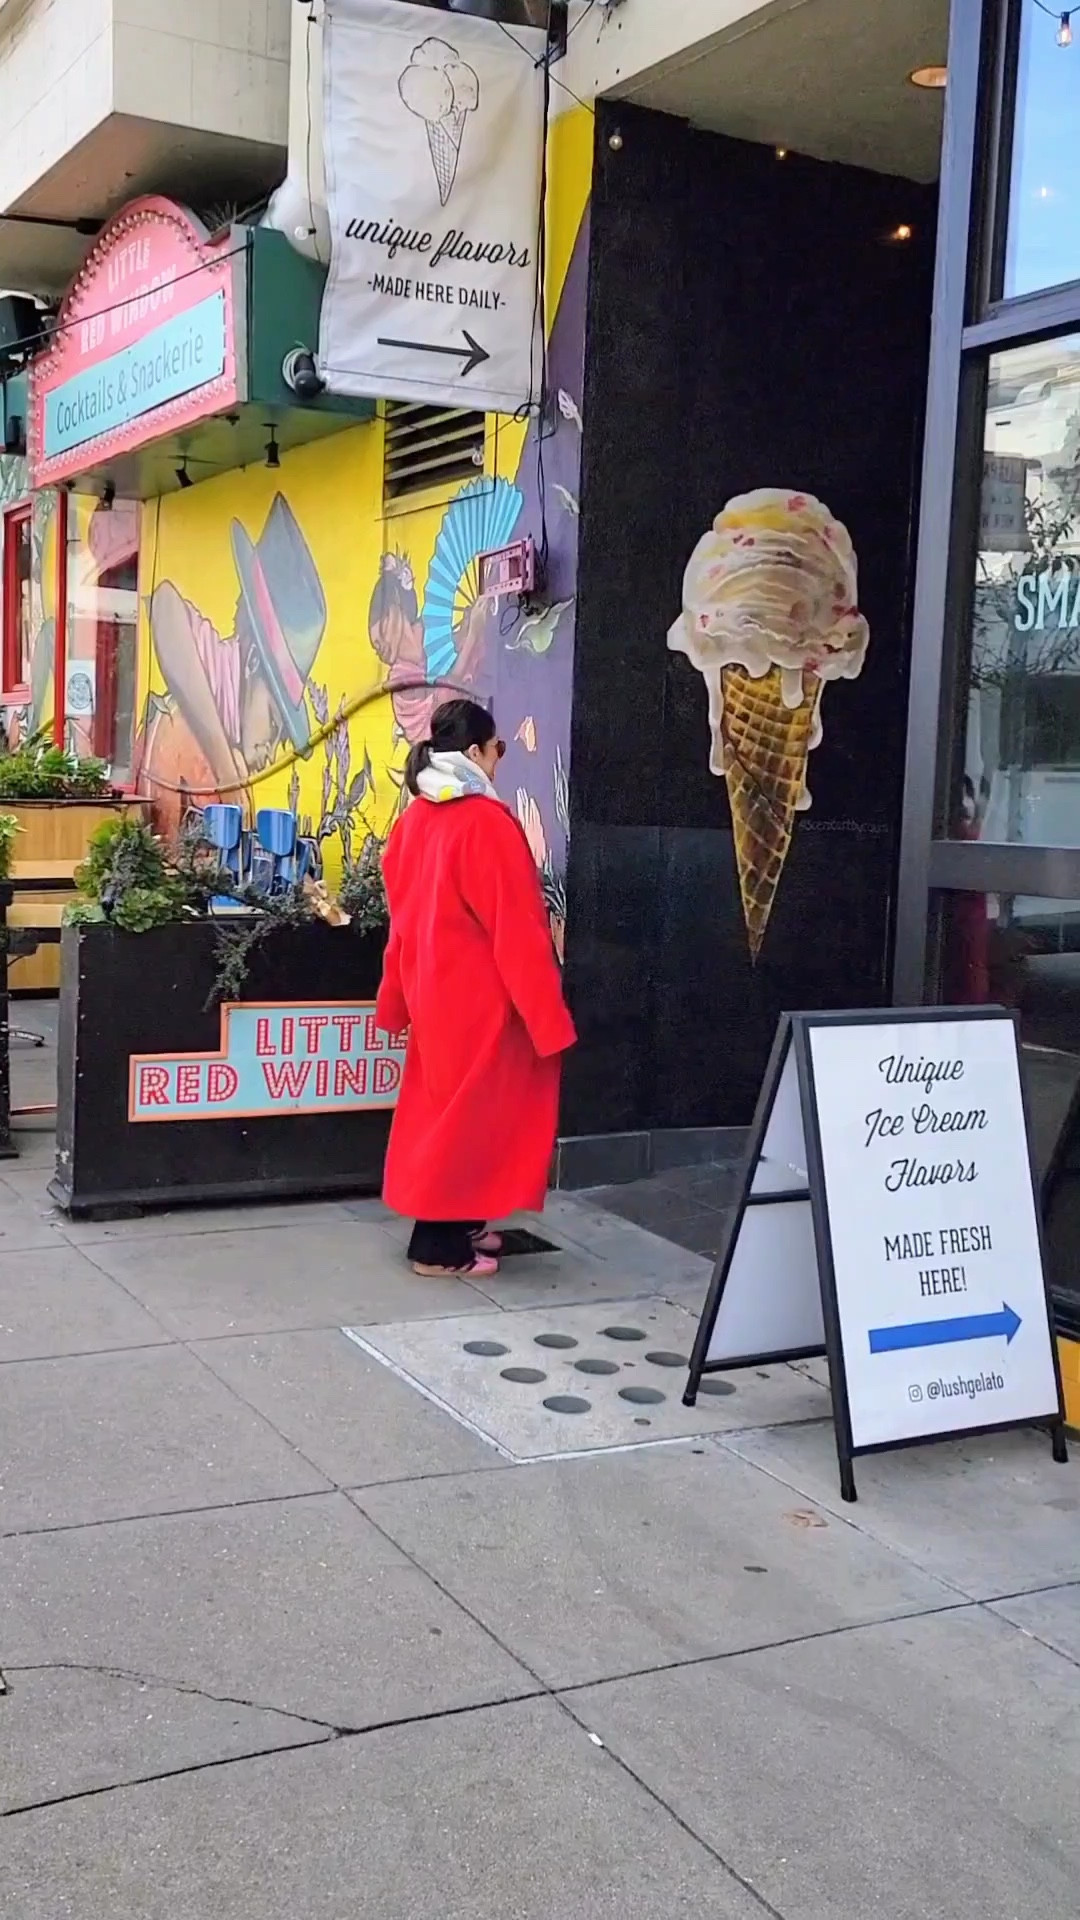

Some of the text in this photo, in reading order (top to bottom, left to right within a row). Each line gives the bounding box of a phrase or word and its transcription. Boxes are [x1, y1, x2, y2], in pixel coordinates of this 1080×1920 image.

[345, 217, 531, 268] unique flavors
[108, 237, 151, 295] LITTLE
[80, 263, 177, 355] RED WINDOW
[415, 281, 454, 304] HERE
[56, 327, 204, 435] Cocktails & Snackerie
[139, 1063, 239, 1105] RED
[878, 1055, 965, 1094] Unique
[865, 1103, 989, 1147] Ice Cream
[885, 1158, 979, 1192] Flavors
[884, 1225, 992, 1261] MADE FRESH
[919, 1266, 968, 1297] HERE!
[927, 1371, 1004, 1400] @lushgelato
